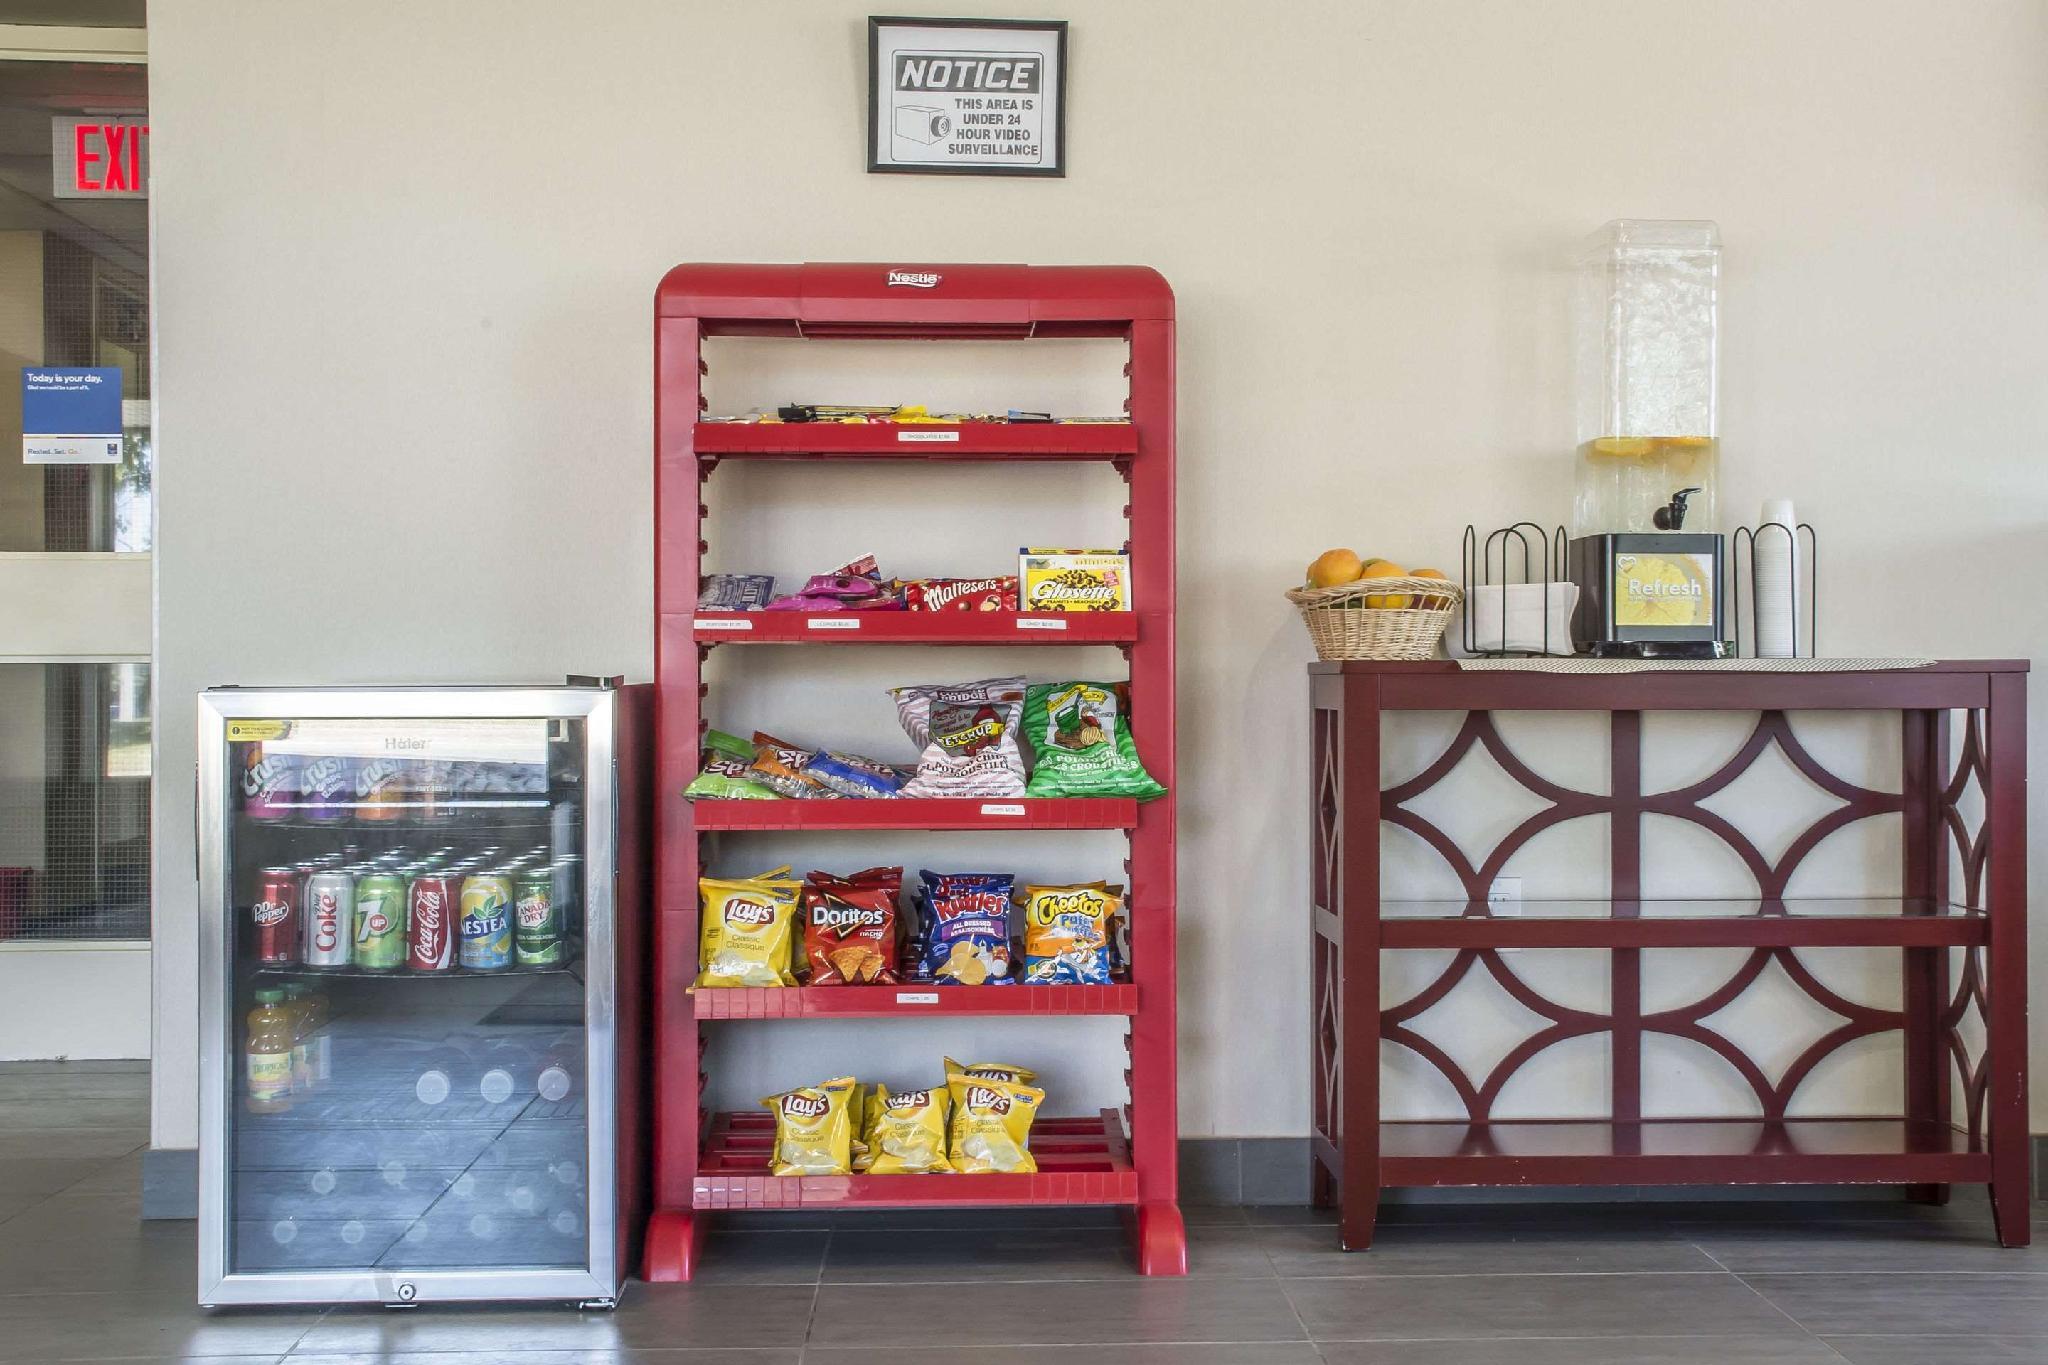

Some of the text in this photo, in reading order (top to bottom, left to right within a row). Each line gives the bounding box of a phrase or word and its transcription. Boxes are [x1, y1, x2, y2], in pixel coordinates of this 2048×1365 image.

[900, 60, 1035, 89] NOTICE
[954, 99, 1034, 110] THIS AREA IS
[963, 114, 1021, 125] UNDER 24
[956, 130, 1031, 141] HOUR VIDEO
[948, 144, 1039, 156] SURVEILLANCE
[27, 373, 103, 384] Today is your day.
[923, 579, 997, 612] Maltesers
[1031, 580, 1116, 600] Glosette
[1628, 579, 1702, 596] Refresh
[385, 738, 432, 750] Haier
[254, 903, 287, 923] Pepper
[262, 901, 277, 911] Dr
[726, 900, 773, 924] Lay's
[1037, 892, 1104, 925] Cheetos
[316, 895, 337, 951] Coke
[357, 900, 386, 942] 7 UP
[524, 910, 544, 924] DRY
[813, 906, 884, 925] Doritos
[415, 887, 440, 964] Coca-Cola
[726, 941, 765, 952] Classique
[731, 934, 761, 943] Classic
[784, 1095, 827, 1117] Lay's
